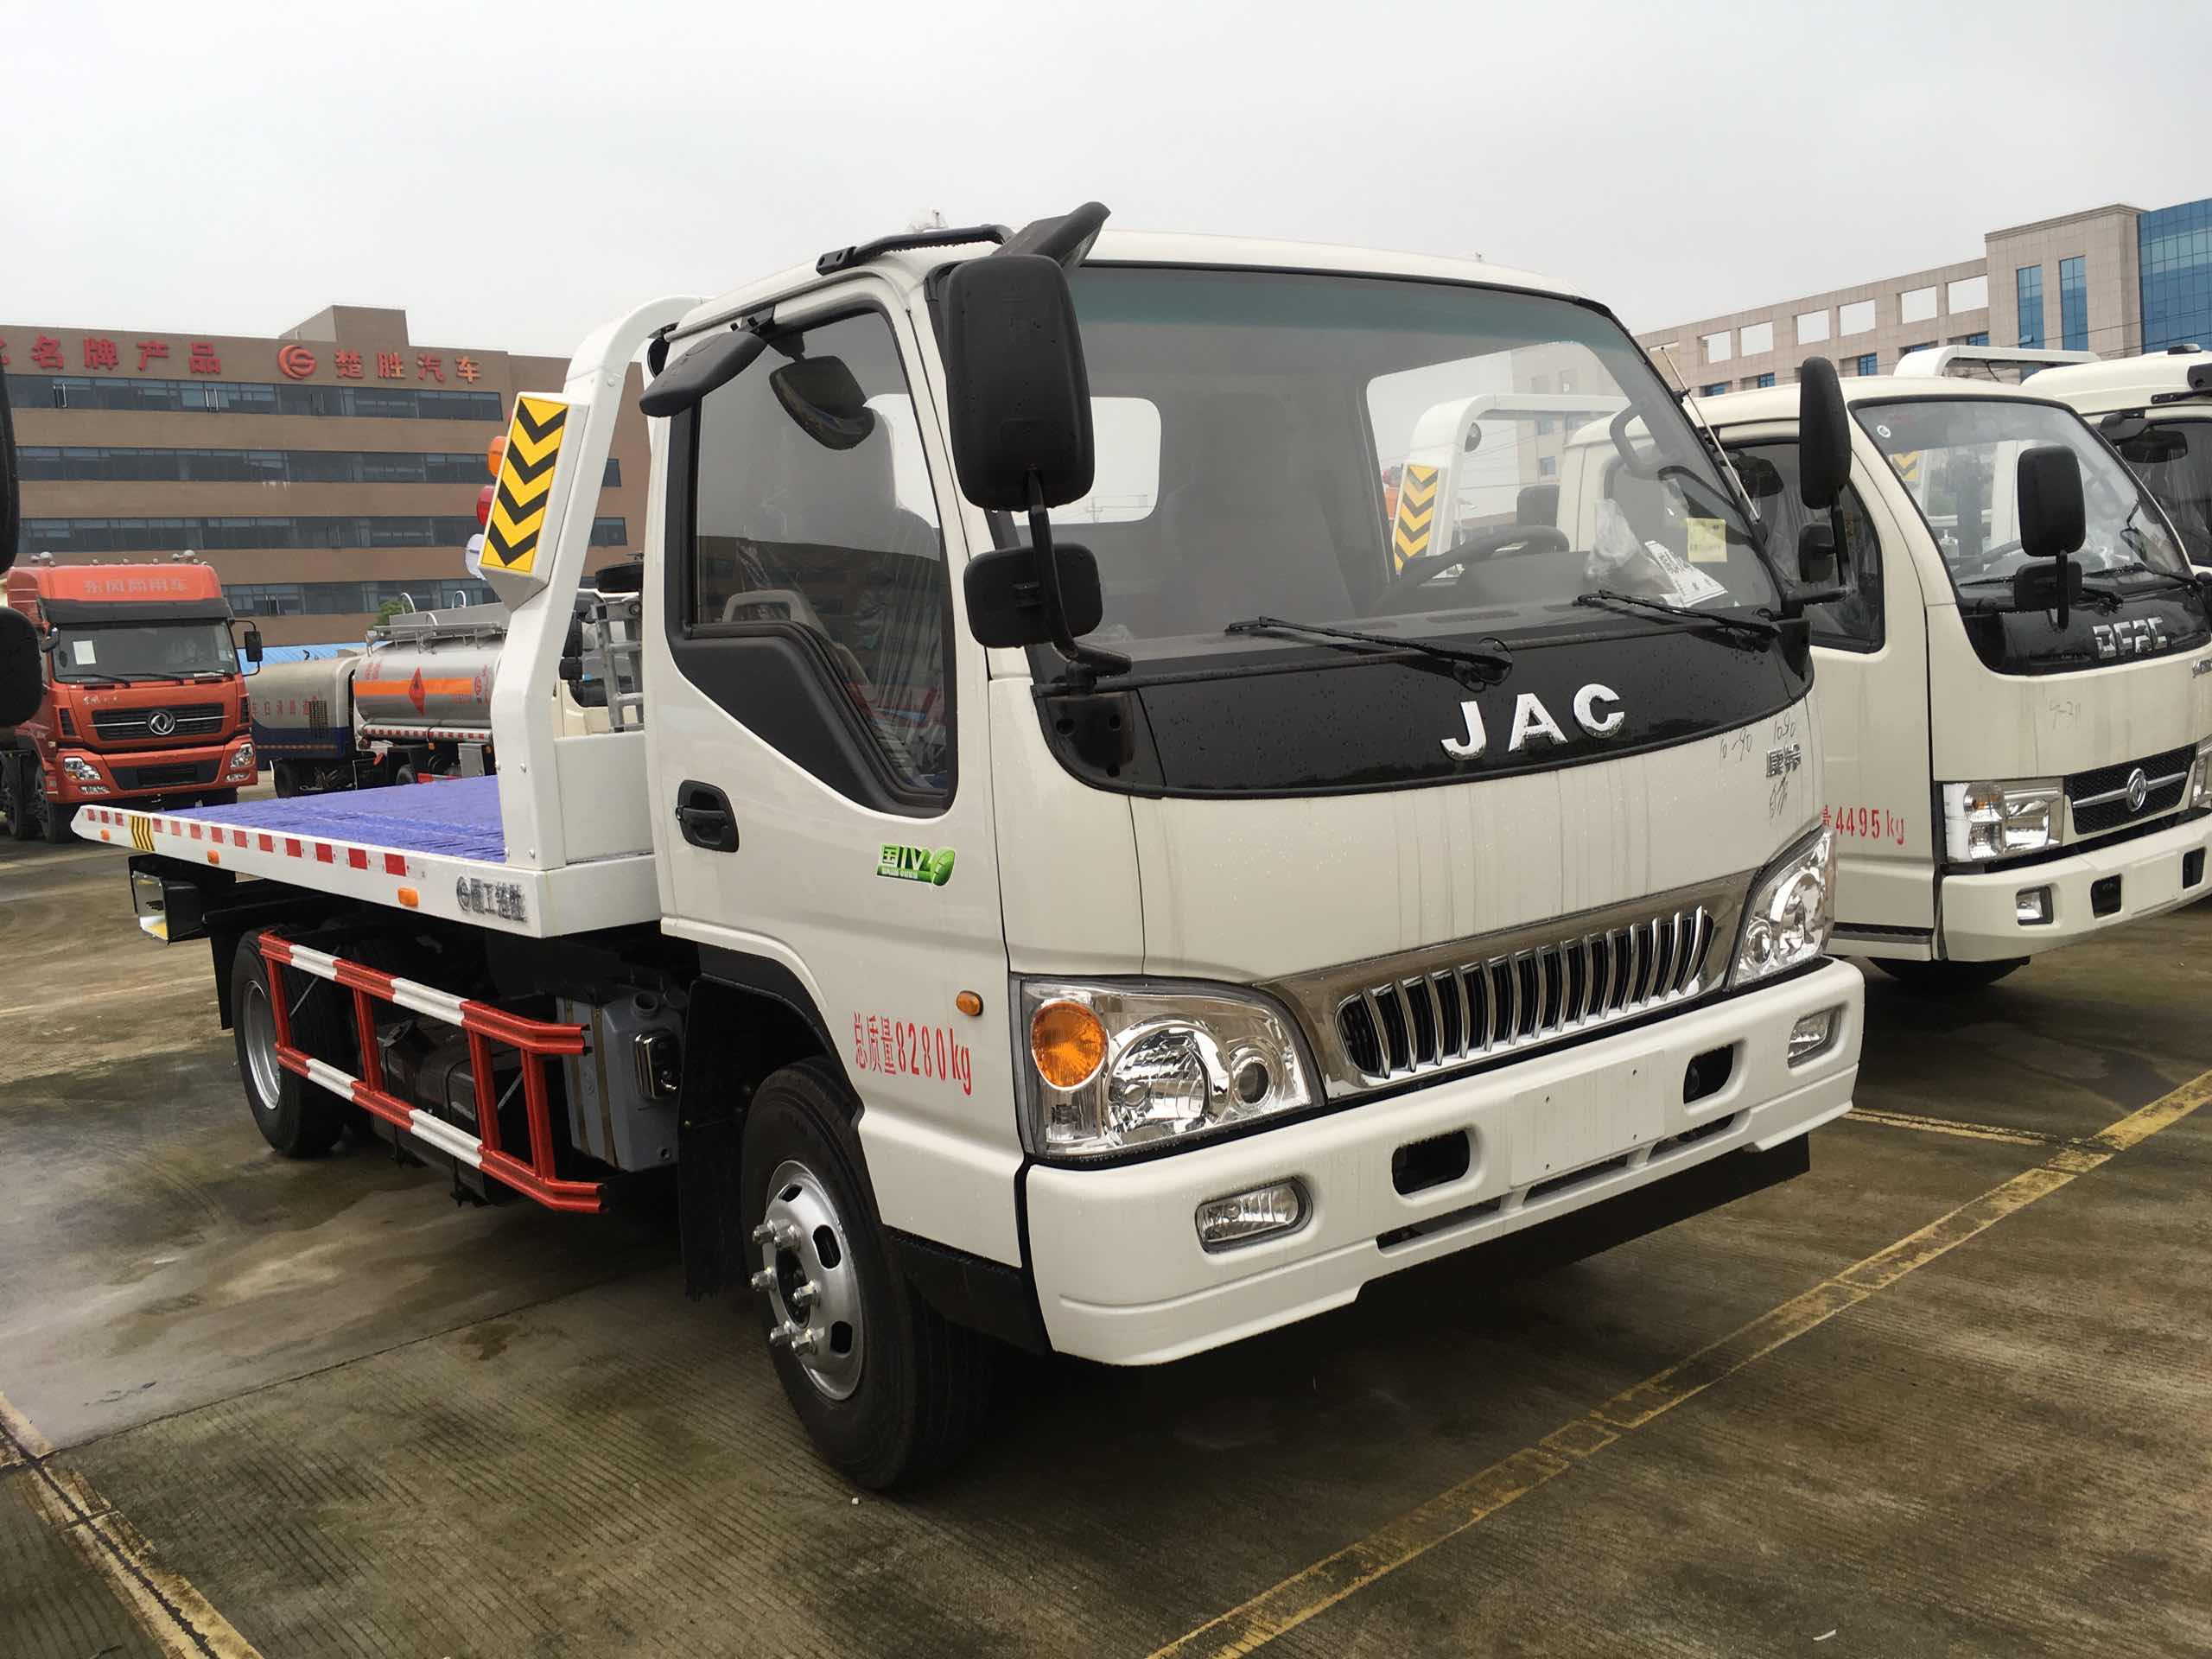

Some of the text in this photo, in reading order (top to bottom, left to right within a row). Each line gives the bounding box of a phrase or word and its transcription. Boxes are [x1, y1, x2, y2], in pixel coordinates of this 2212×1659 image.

[334, 348, 482, 385] 楚胜汽车
[1440, 683, 1625, 761] JAC
